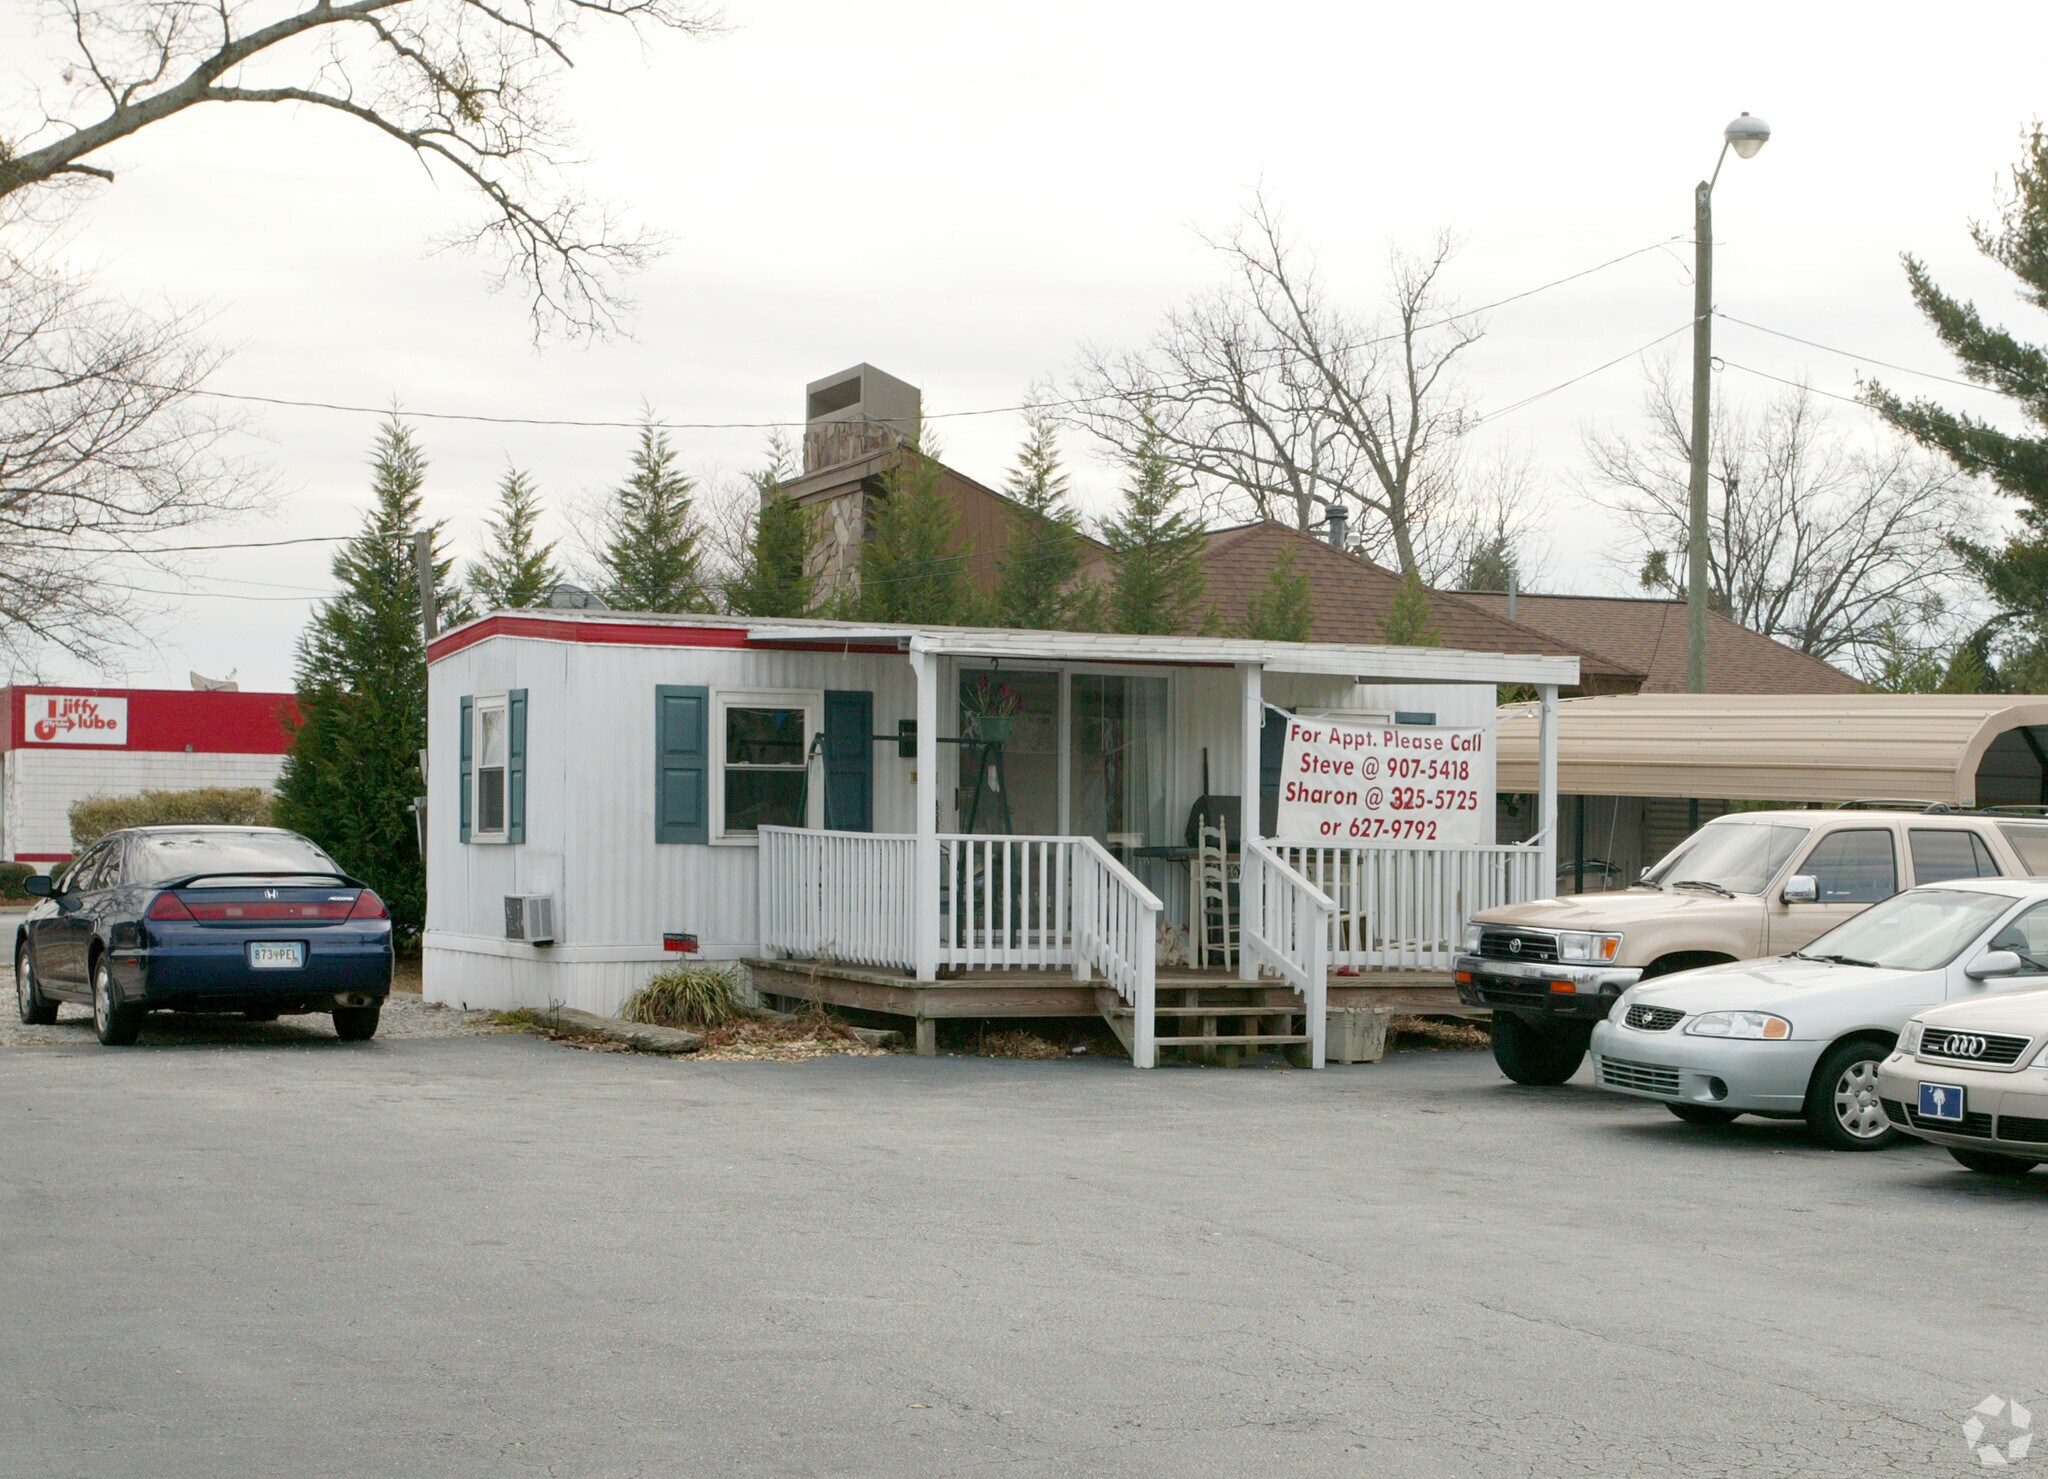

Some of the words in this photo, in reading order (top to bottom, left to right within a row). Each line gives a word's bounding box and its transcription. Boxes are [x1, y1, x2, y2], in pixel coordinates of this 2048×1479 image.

[59, 698, 98, 718] jiffy
[78, 713, 117, 729] lube
[1290, 724, 1322, 742] For
[1328, 727, 1377, 751] Appt.
[1383, 730, 1443, 751] Please
[1450, 734, 1482, 752] Call
[1299, 752, 1354, 775] Steve
[1361, 757, 1380, 780] @
[1387, 758, 1469, 781] 907-5418
[1285, 781, 1358, 805] Sharon
[1365, 786, 1383, 810] @
[1389, 787, 1478, 811] 325-5725
[1319, 820, 1341, 836] or
[1349, 817, 1437, 840] 627-9792
